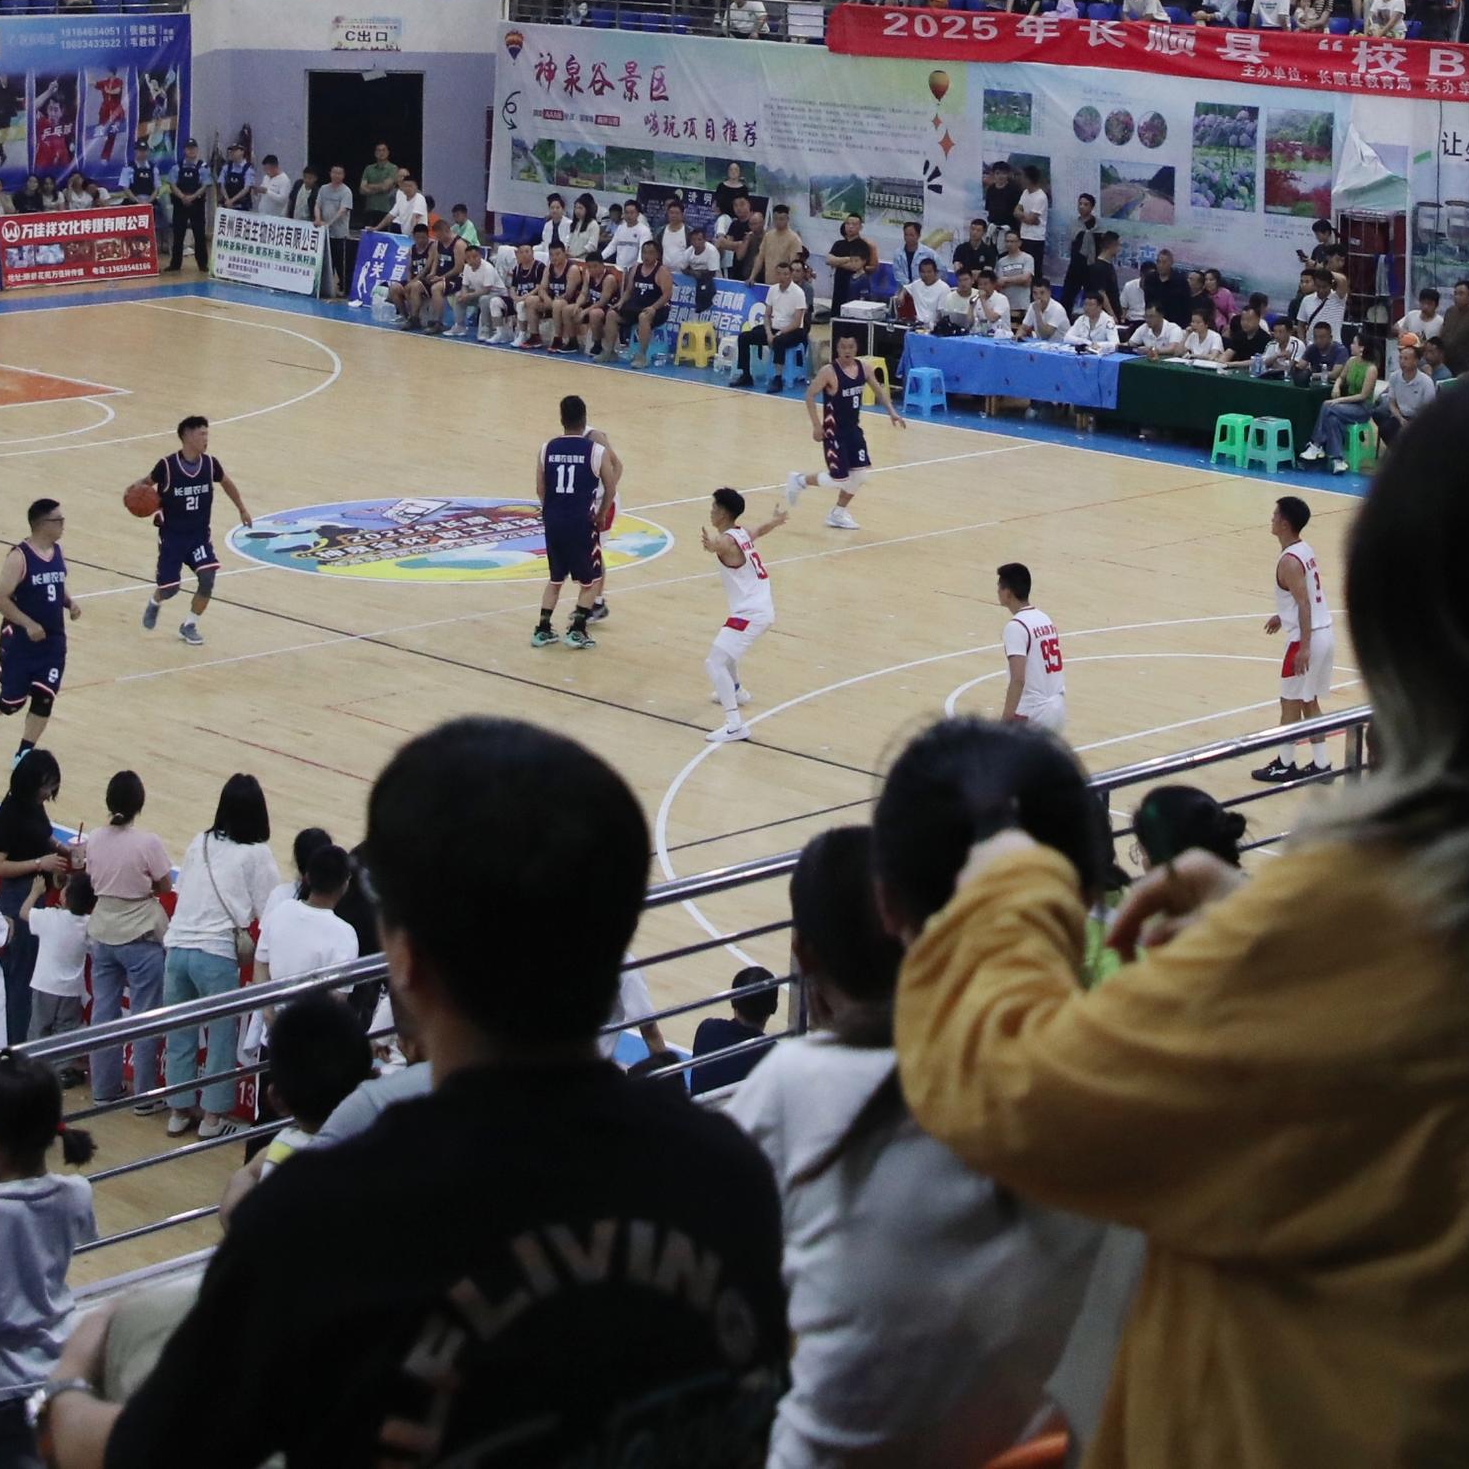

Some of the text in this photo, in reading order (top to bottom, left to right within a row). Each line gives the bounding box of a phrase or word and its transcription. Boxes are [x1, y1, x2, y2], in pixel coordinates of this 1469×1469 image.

[345, 30, 389, 43] C出口
[534, 52, 670, 102] 神泉谷景区
[644, 110, 759, 148] 嗨玩项目推荐
[21, 214, 150, 240] 万佳祥文化传媒有限公司
[555, 464, 576, 494] 11
[185, 496, 200, 511] 21
[192, 545, 208, 562] 21
[46, 585, 57, 602] 9
[1040, 638, 1064, 675] 95
